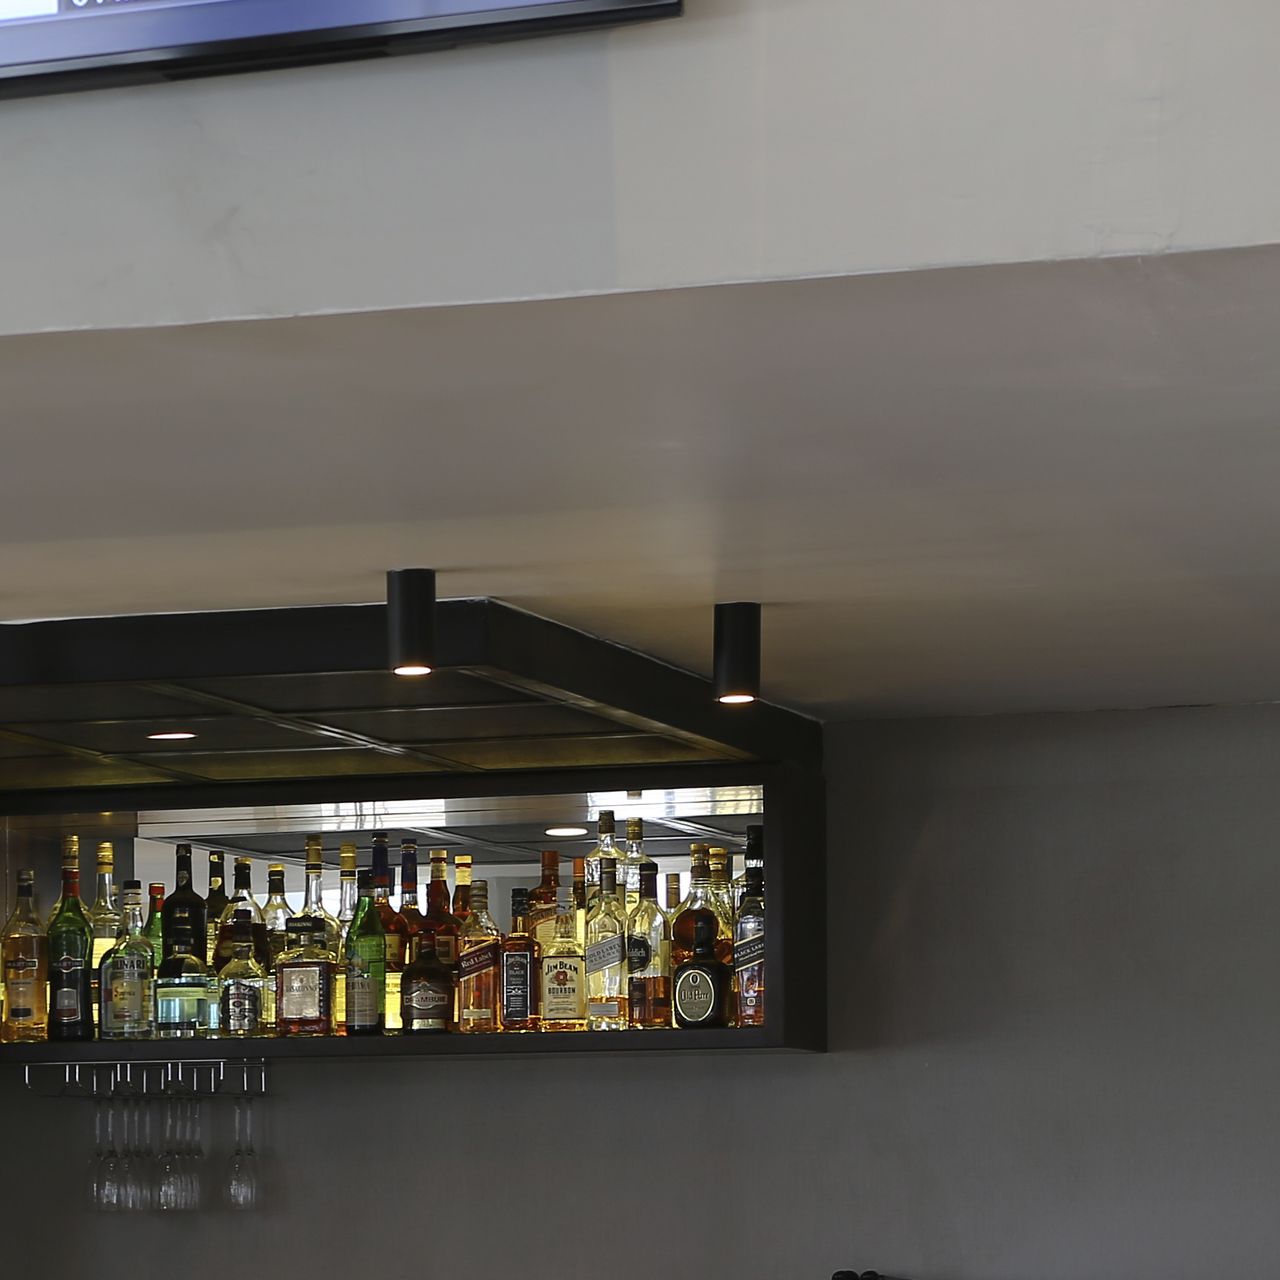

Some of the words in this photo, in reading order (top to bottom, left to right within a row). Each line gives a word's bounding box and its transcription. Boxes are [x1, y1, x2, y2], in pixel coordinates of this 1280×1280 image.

[461, 958, 474, 969] Red
[475, 952, 493, 964] Label
[545, 962, 558, 976] JIM
[559, 961, 578, 974] BEAM
[547, 987, 576, 995] BOURBON
[681, 990, 693, 1002] Old
